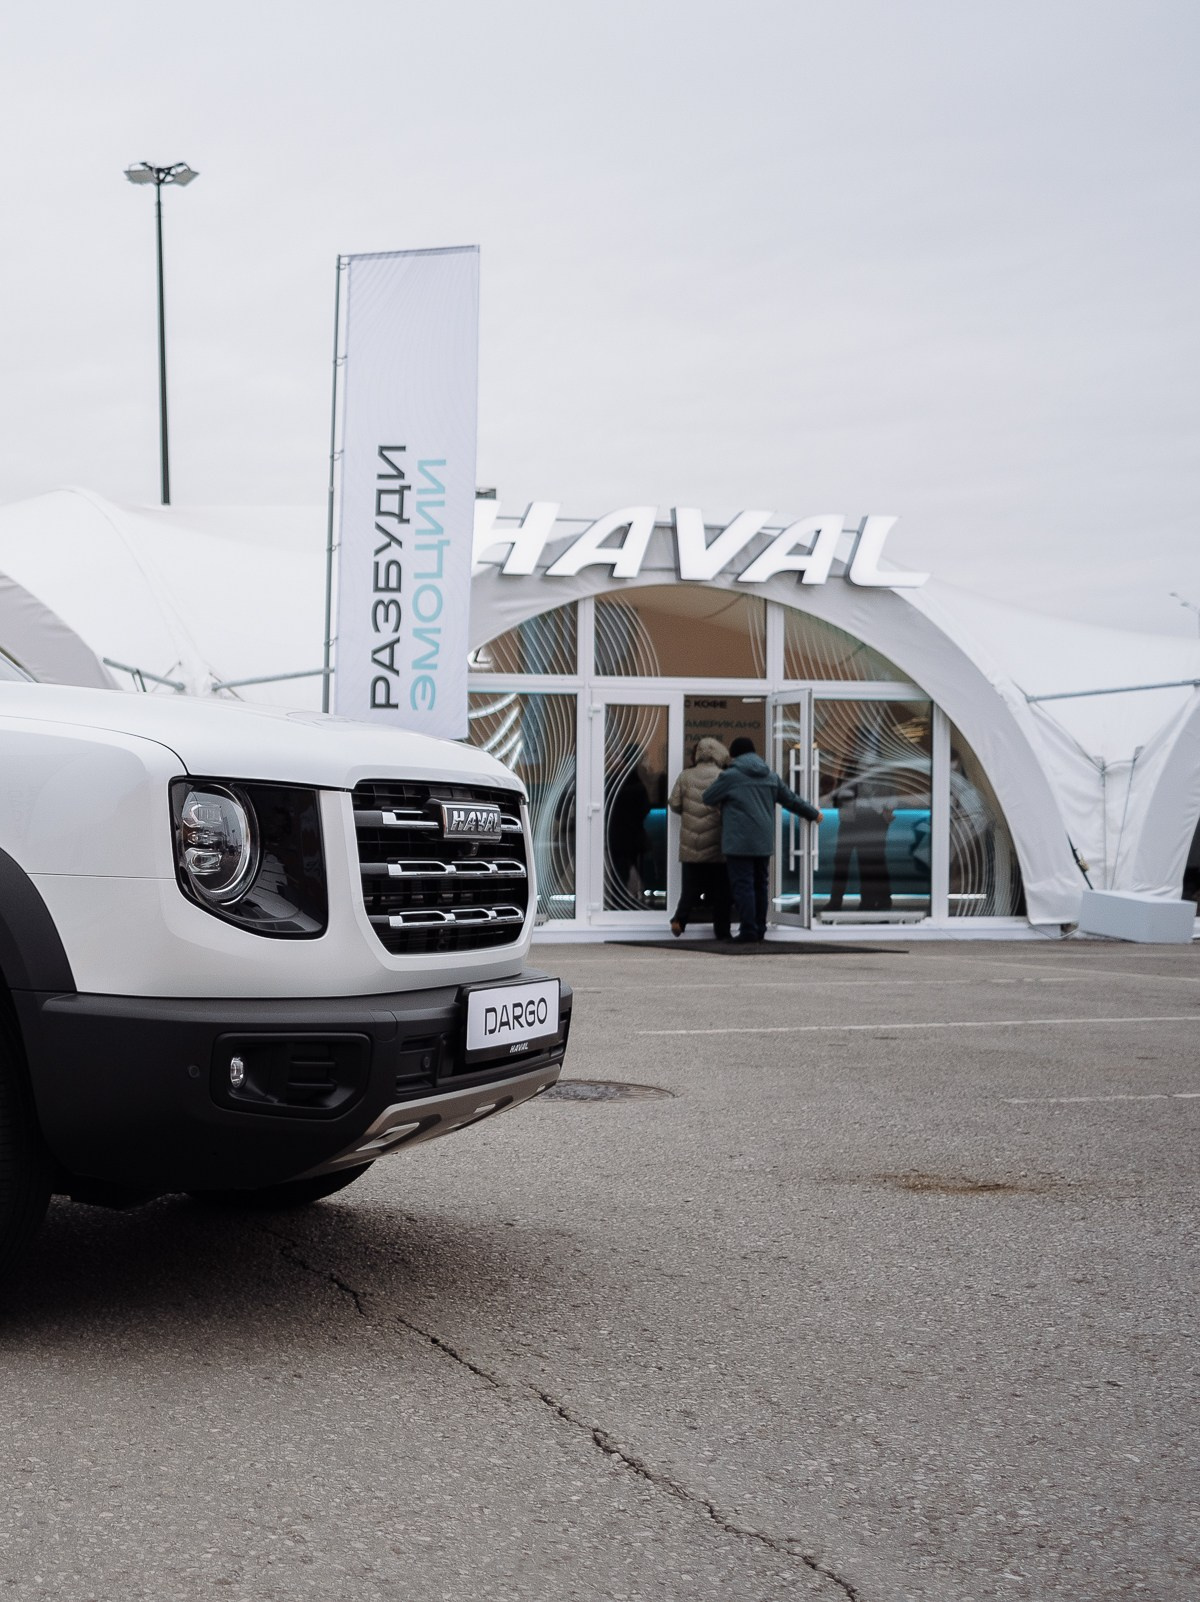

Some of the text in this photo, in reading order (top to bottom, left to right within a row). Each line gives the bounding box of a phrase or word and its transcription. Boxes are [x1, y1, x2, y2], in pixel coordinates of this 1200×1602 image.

[475, 500, 931, 588] HAVAL
[370, 445, 411, 710] РАЗБУДИ
[410, 458, 450, 712] ЭМОЦИИ
[694, 700, 727, 709] КОФЕ
[685, 720, 761, 729] АМЕРИКАНО
[451, 811, 501, 832] HAVAL
[484, 997, 548, 1036] DARGO
[509, 1042, 529, 1053] HAVAL
